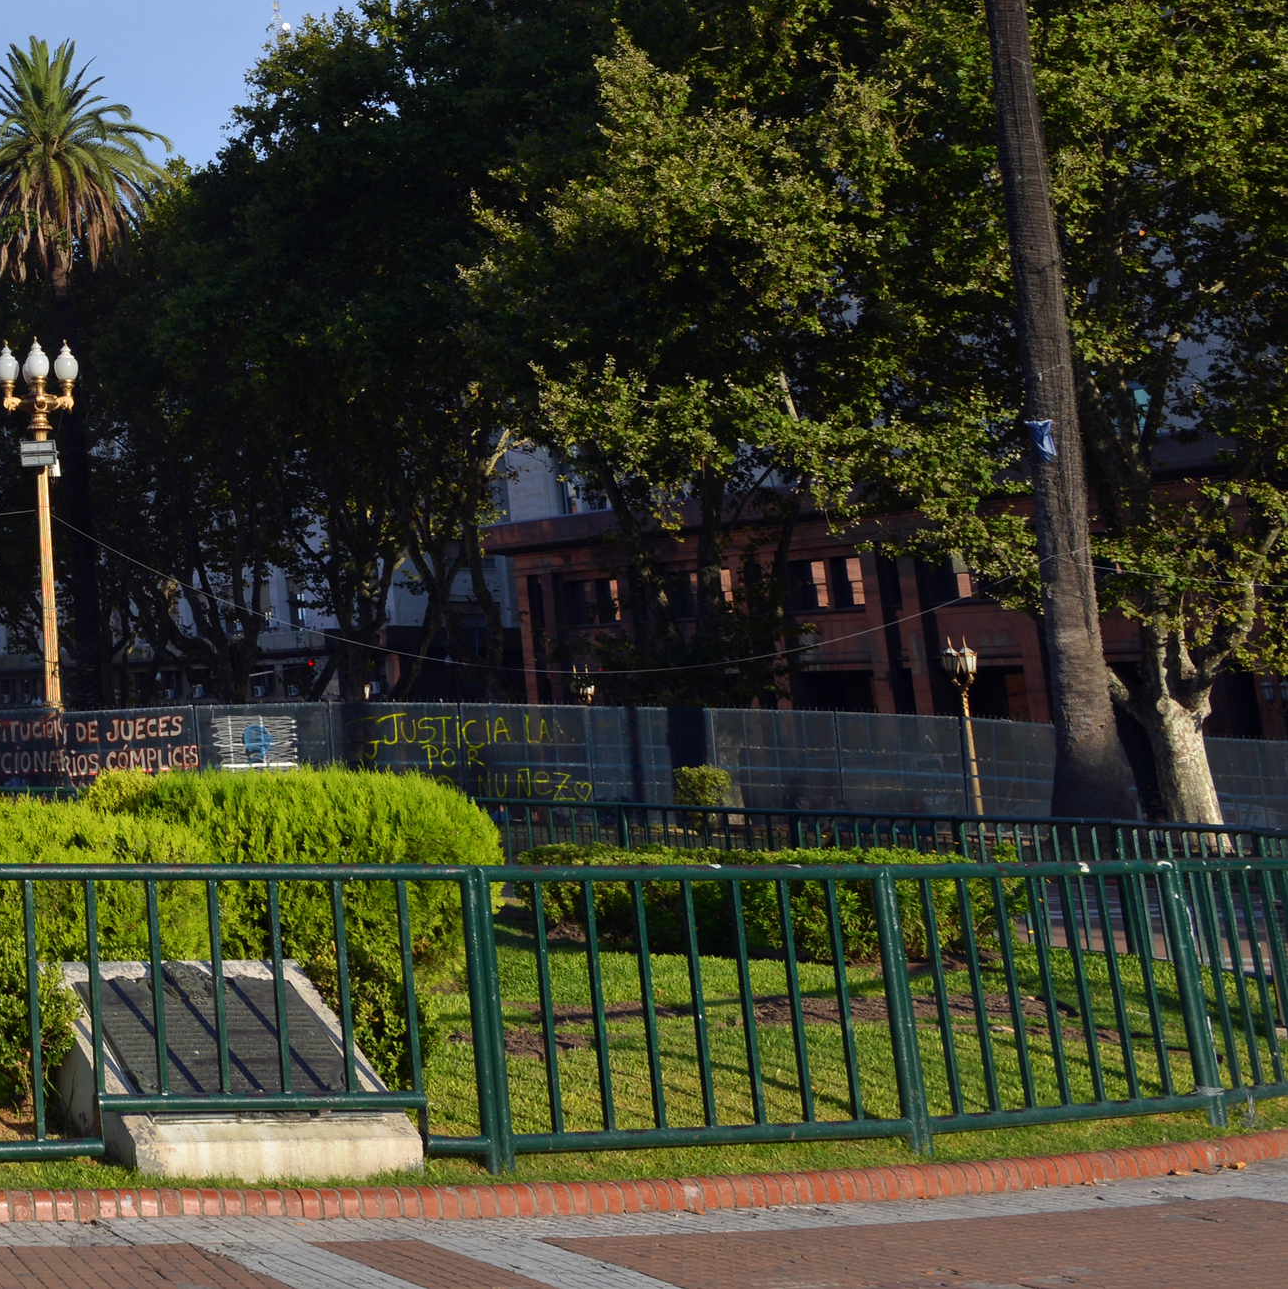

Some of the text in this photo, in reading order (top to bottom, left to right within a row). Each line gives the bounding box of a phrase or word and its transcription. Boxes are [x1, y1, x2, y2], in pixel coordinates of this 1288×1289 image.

[76, 720, 100, 743] DE
[105, 715, 184, 742] JUECES
[421, 744, 488, 769] POR
